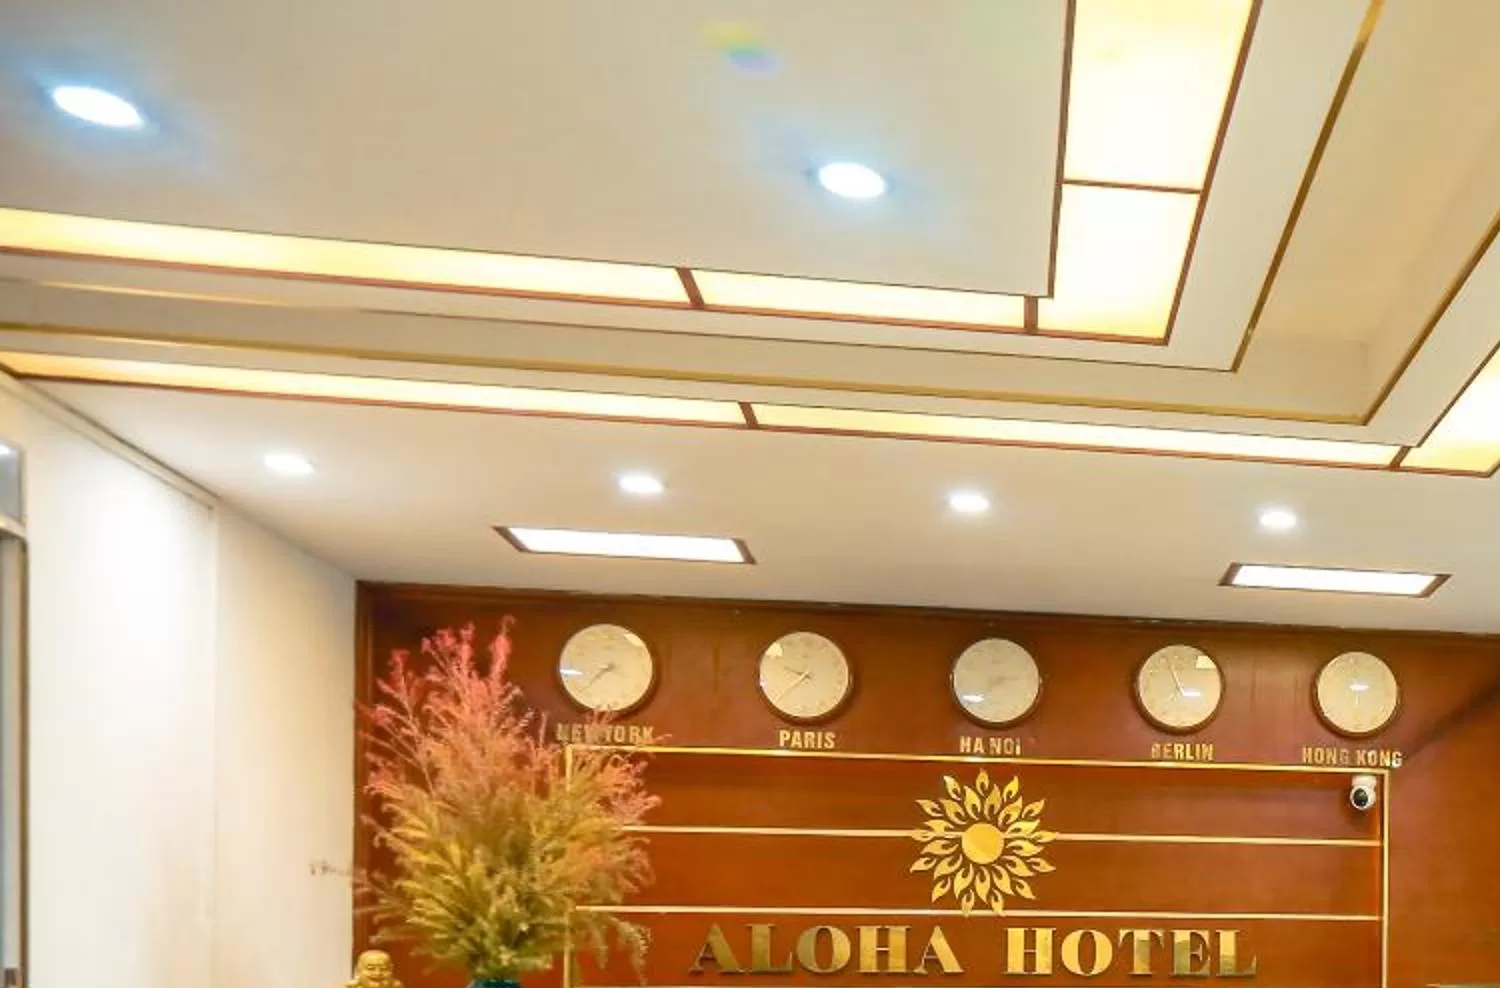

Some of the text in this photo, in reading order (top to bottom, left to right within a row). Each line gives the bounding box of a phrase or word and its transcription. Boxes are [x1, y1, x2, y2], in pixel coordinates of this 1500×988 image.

[779, 729, 837, 750] PARIS
[1151, 742, 1214, 761] BERLIN
[1302, 747, 1403, 768] HONG KONG
[687, 922, 1258, 979] ALOHA HOTEL
